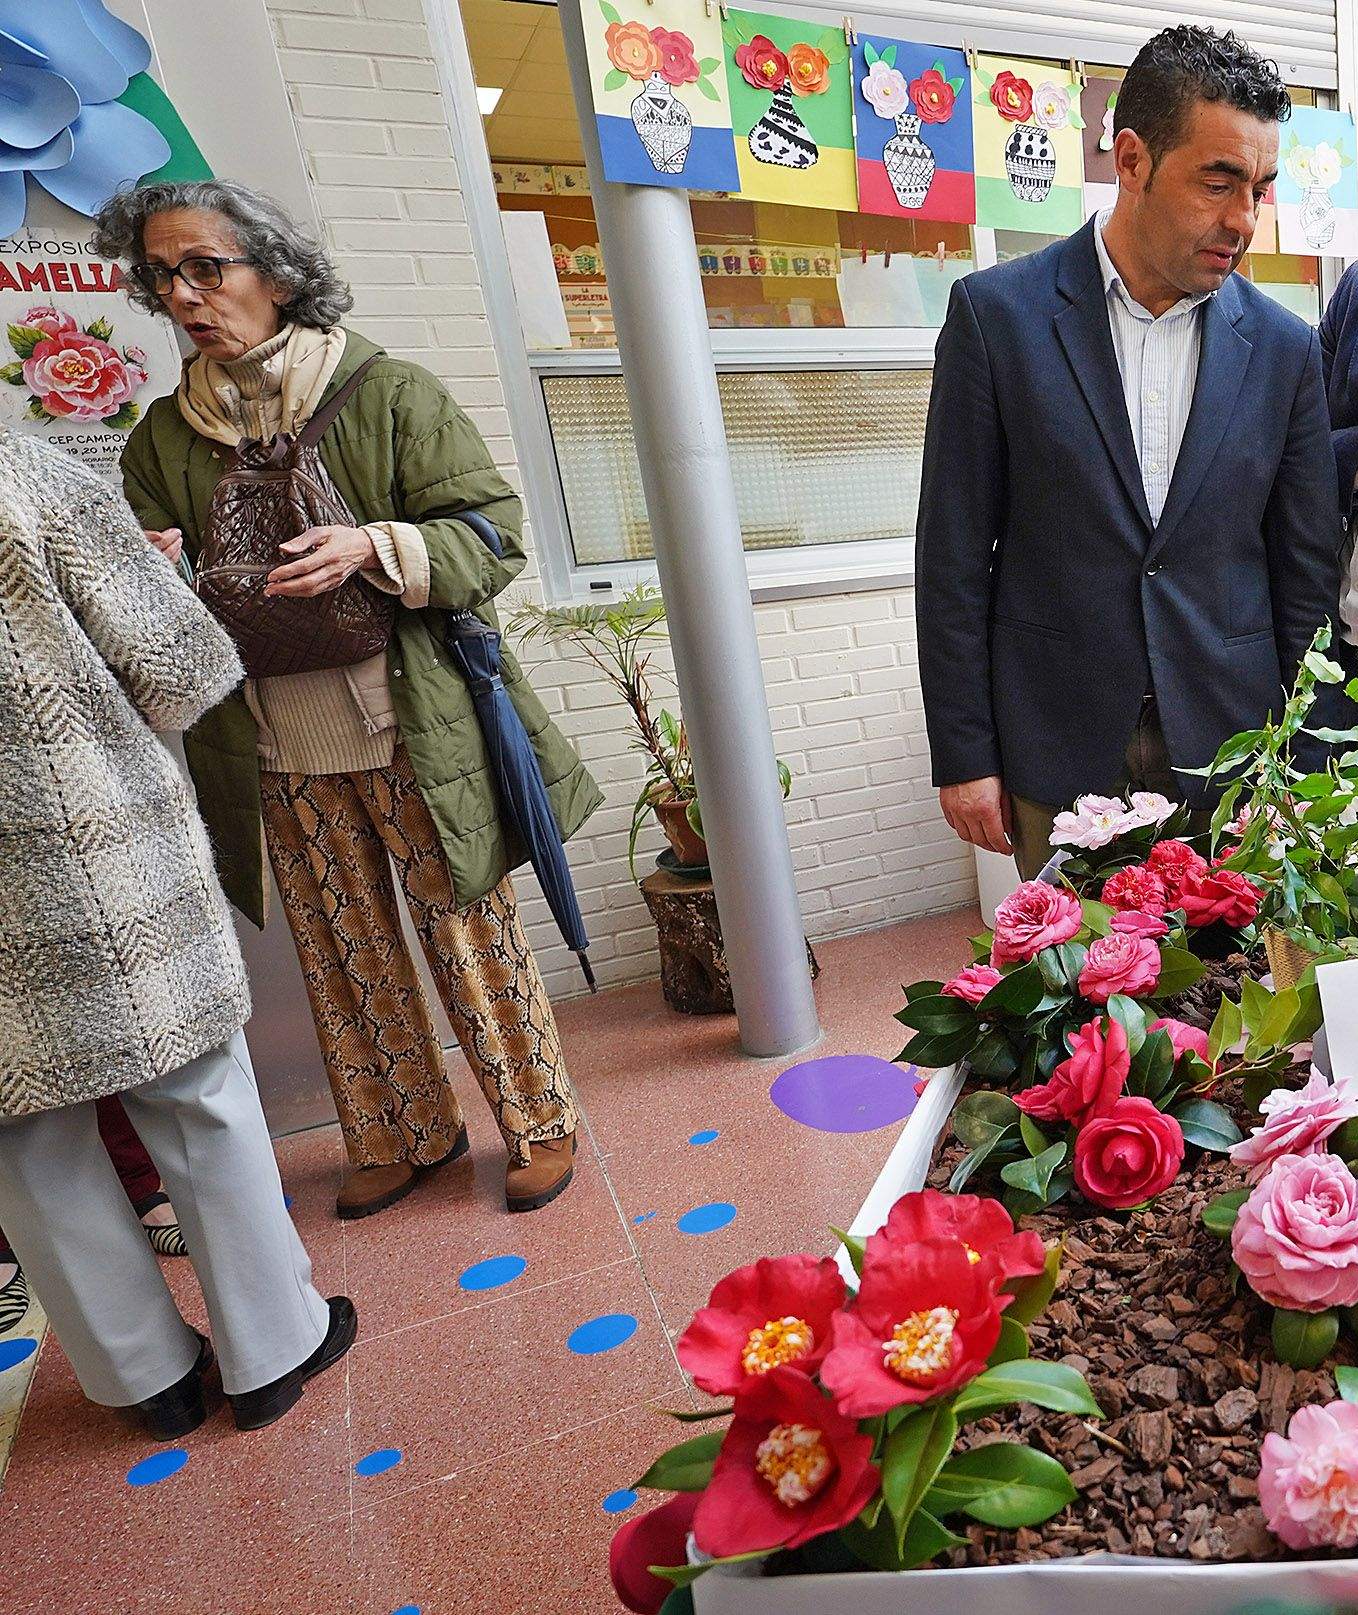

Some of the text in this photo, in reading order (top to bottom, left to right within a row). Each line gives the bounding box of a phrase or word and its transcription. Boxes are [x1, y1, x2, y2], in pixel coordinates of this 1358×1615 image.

[0, 240, 100, 255] EXPOSIC
[0, 260, 133, 292] AMELIA
[48, 433, 129, 445] CEP CAMPOL
